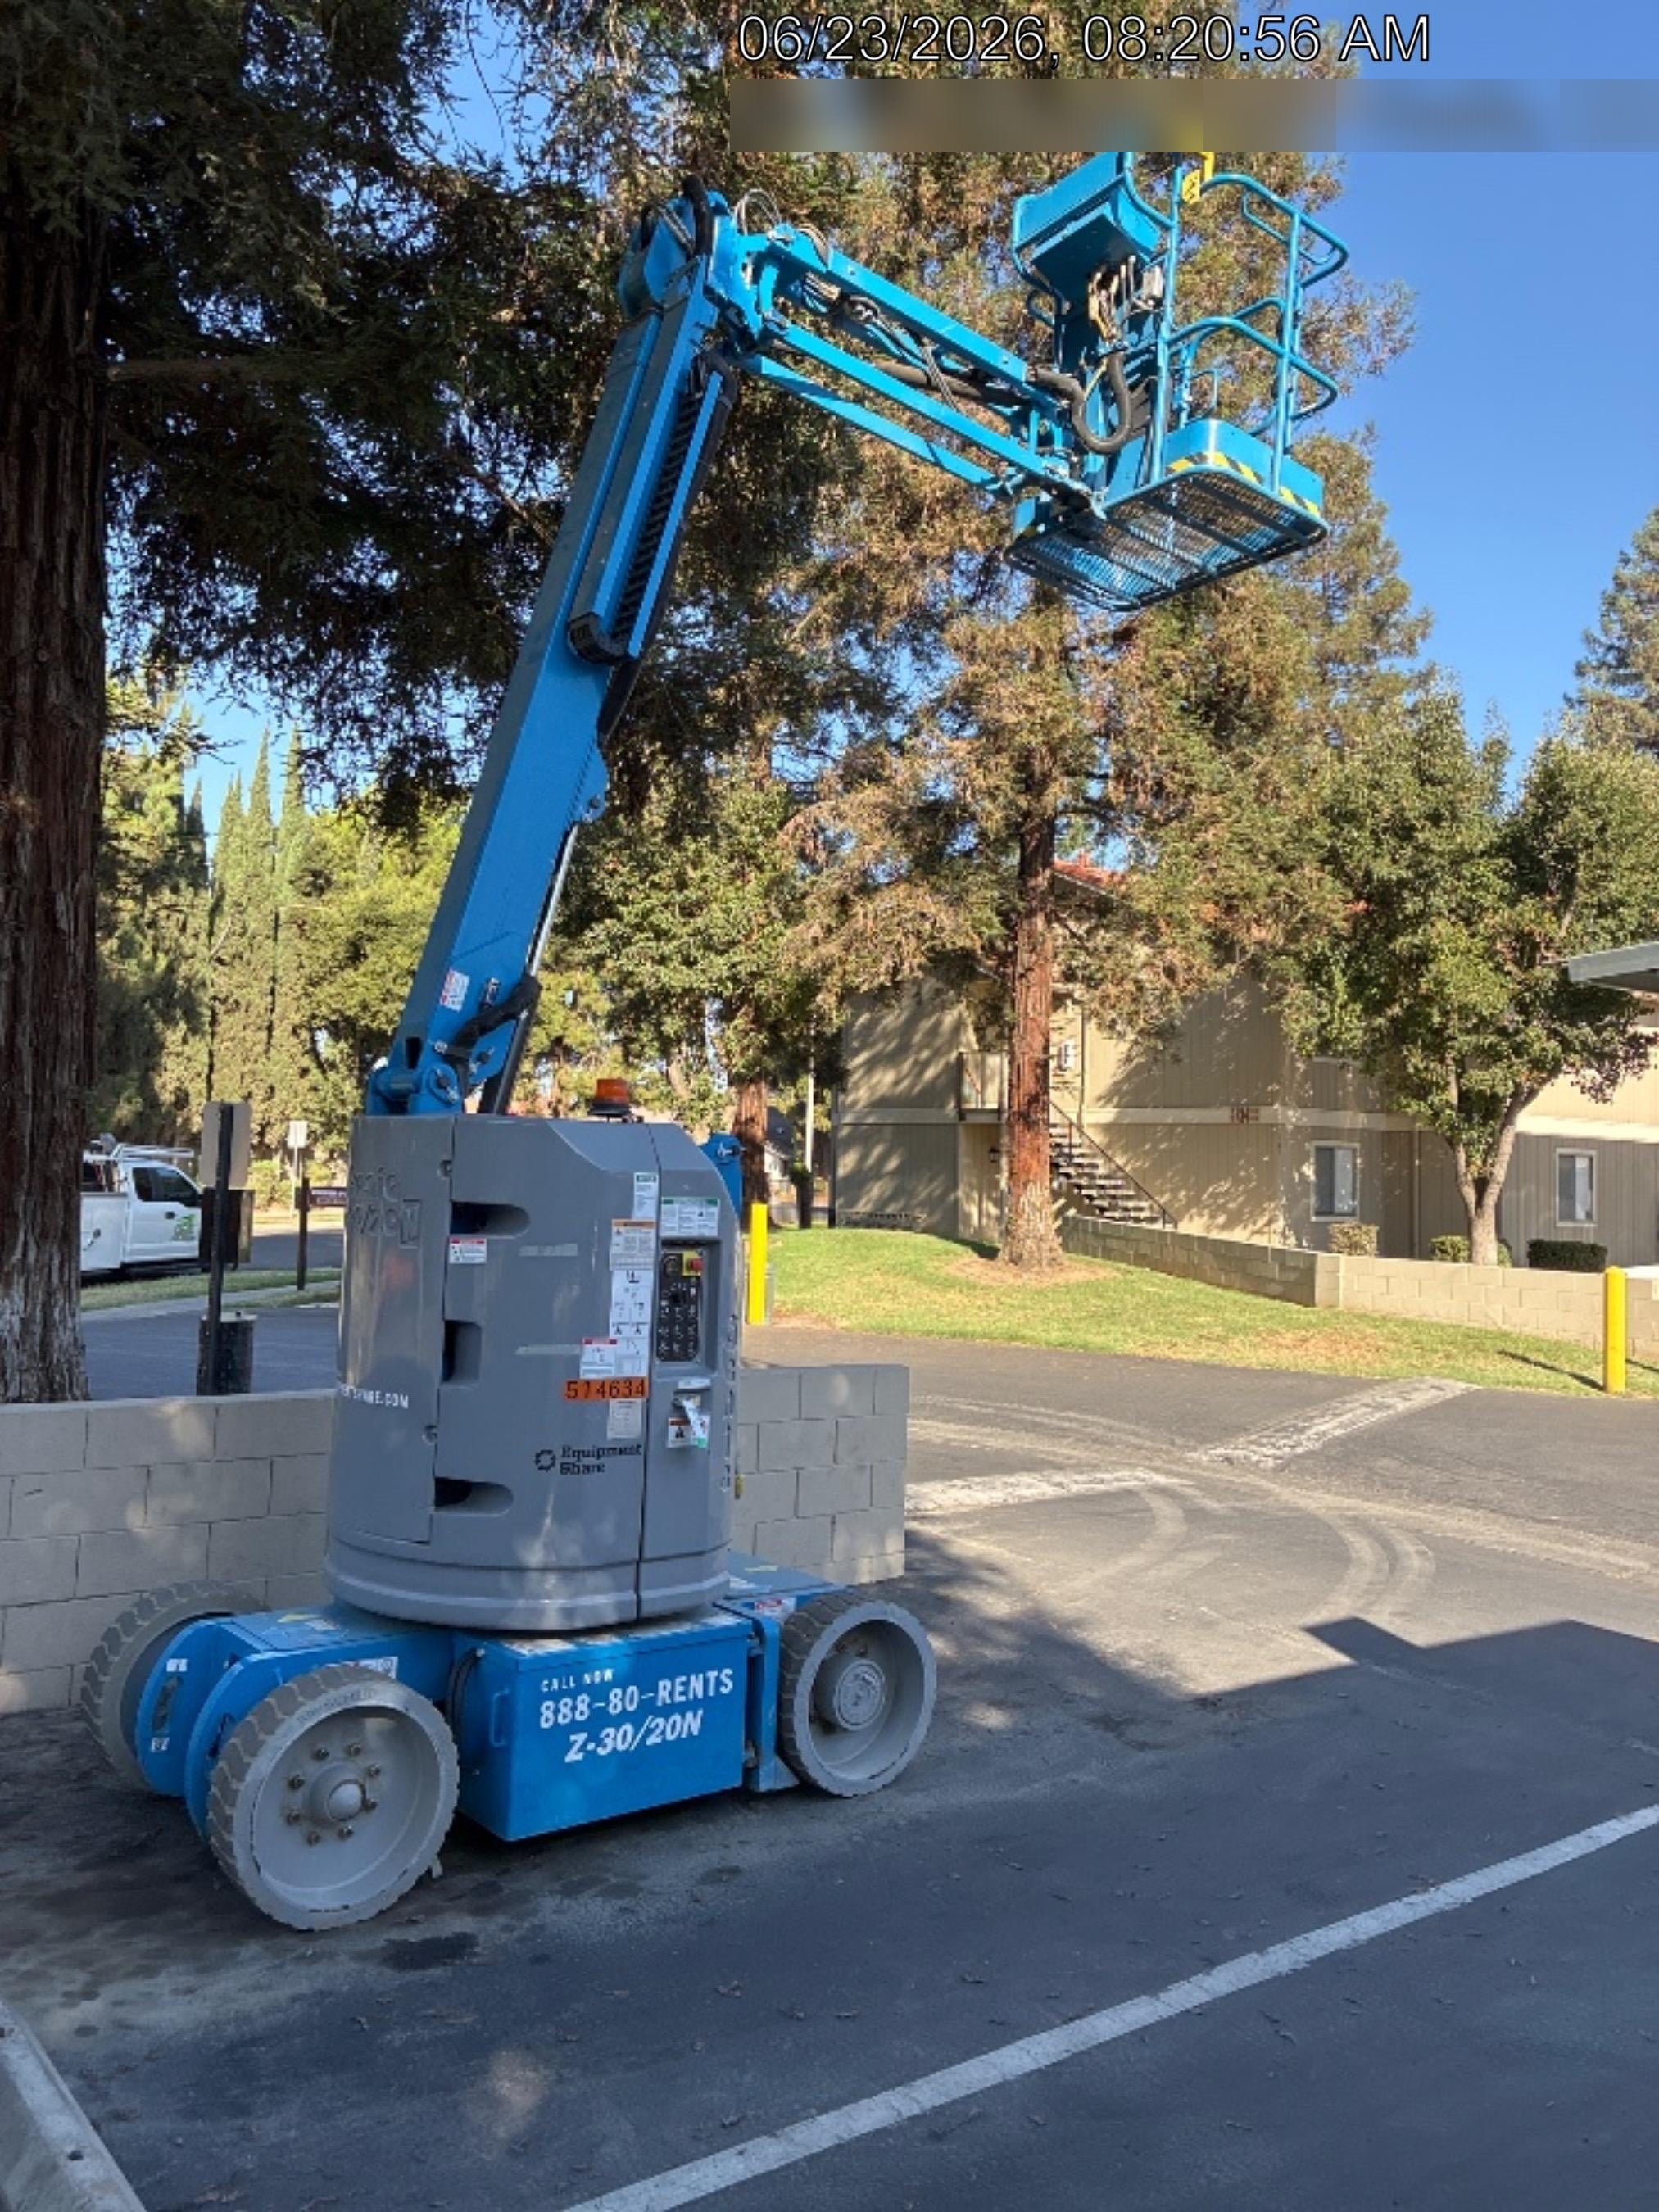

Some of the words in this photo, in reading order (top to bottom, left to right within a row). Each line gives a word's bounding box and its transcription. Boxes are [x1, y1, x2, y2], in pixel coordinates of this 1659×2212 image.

[566, 1378, 645, 1399] 574634
[561, 1444, 641, 1462] Equipment
[541, 1676, 575, 1692] CALL
[583, 1669, 614, 1684] NOW
[540, 1668, 734, 1729] 888-80-RENTS
[564, 1709, 704, 1763] Z-30/20N
